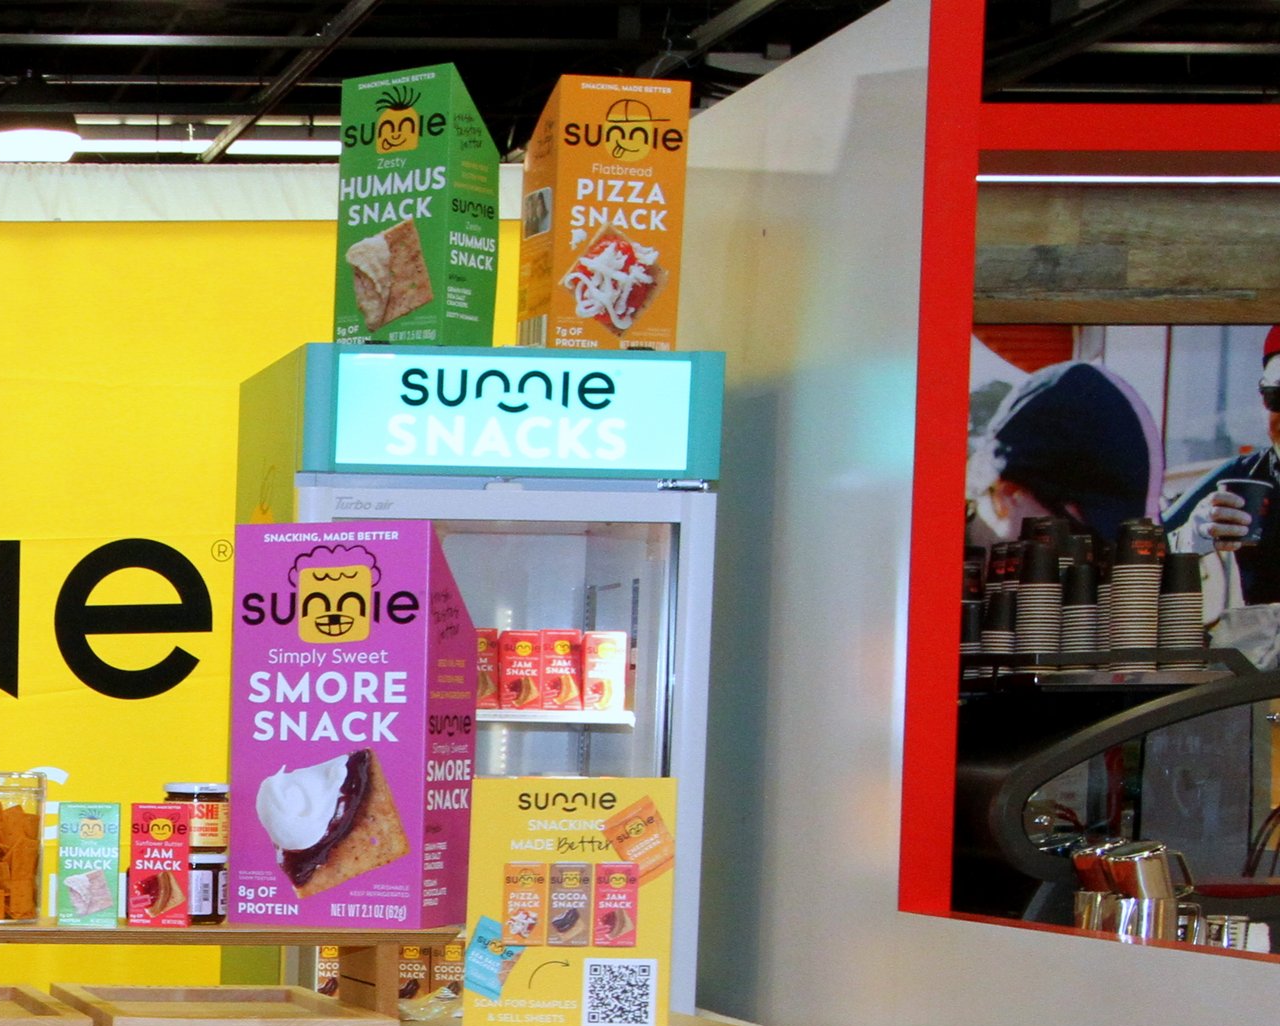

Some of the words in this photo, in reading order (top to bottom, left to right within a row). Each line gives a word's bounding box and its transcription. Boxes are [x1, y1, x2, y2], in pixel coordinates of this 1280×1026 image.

[581, 82, 620, 92] SNACKING,
[621, 84, 643, 93] MADE
[644, 85, 672, 95] BETTER
[344, 112, 447, 148] sunnie
[564, 122, 683, 152] sunnie
[377, 157, 407, 171] Zesty
[592, 162, 653, 178] Flatbread
[340, 166, 447, 201] HUMMUS
[576, 178, 666, 205] PIZZA
[347, 196, 433, 226] SNACK
[452, 198, 495, 219] sunnie
[570, 205, 668, 232] SNACK
[449, 231, 496, 252] HUMMUS
[450, 249, 493, 271] SNACK
[347, 325, 359, 334] OF
[555, 326, 567, 337] 7g
[569, 327, 583, 336] OF
[555, 338, 598, 348] PROTEIN
[400, 368, 616, 412] sunnie
[385, 413, 627, 461] SNACKS
[335, 496, 372, 512] Turbo
[375, 498, 395, 512] air
[264, 533, 321, 543] SNACKING,
[323, 532, 355, 541] MADE
[357, 531, 399, 541] BETTER
[242, 591, 419, 625] sunnie
[268, 648, 327, 667] Simply
[332, 648, 389, 664] Sweet
[511, 660, 532, 668] JAM
[550, 659, 572, 667] JAM
[506, 668, 538, 676] SNACK
[545, 666, 577, 675] SNACK
[248, 671, 407, 704] SMORE
[252, 710, 400, 742] SNACK
[426, 759, 471, 782] SMORE
[426, 788, 469, 811] SNACK
[518, 792, 617, 812] sunnie
[132, 822, 187, 835] sunnie
[528, 819, 605, 831] SNACKING
[59, 846, 119, 858] HUMMUS
[511, 839, 554, 851] MADE
[556, 836, 613, 855] Better
[144, 848, 173, 859] JAM
[64, 859, 112, 870] SNACK
[135, 860, 182, 871] SNACK
[237, 885, 255, 900] 8g
[257, 886, 278, 897] OF
[509, 892, 540, 900] PIZZA
[551, 892, 588, 900] COCOA
[237, 903, 299, 915] PROTEIN
[330, 903, 346, 917] NET
[347, 904, 360, 917] WT
[361, 904, 372, 918] 2.1
[373, 905, 384, 919] OZ
[598, 901, 633, 909] SNACK
[399, 963, 428, 971] OCOA
[399, 971, 425, 979] NACK
[506, 999, 525, 1008] FOR
[528, 999, 577, 1009] SAMPLES
[497, 1013, 522, 1022] SELL
[524, 1014, 565, 1023] SHEETS
